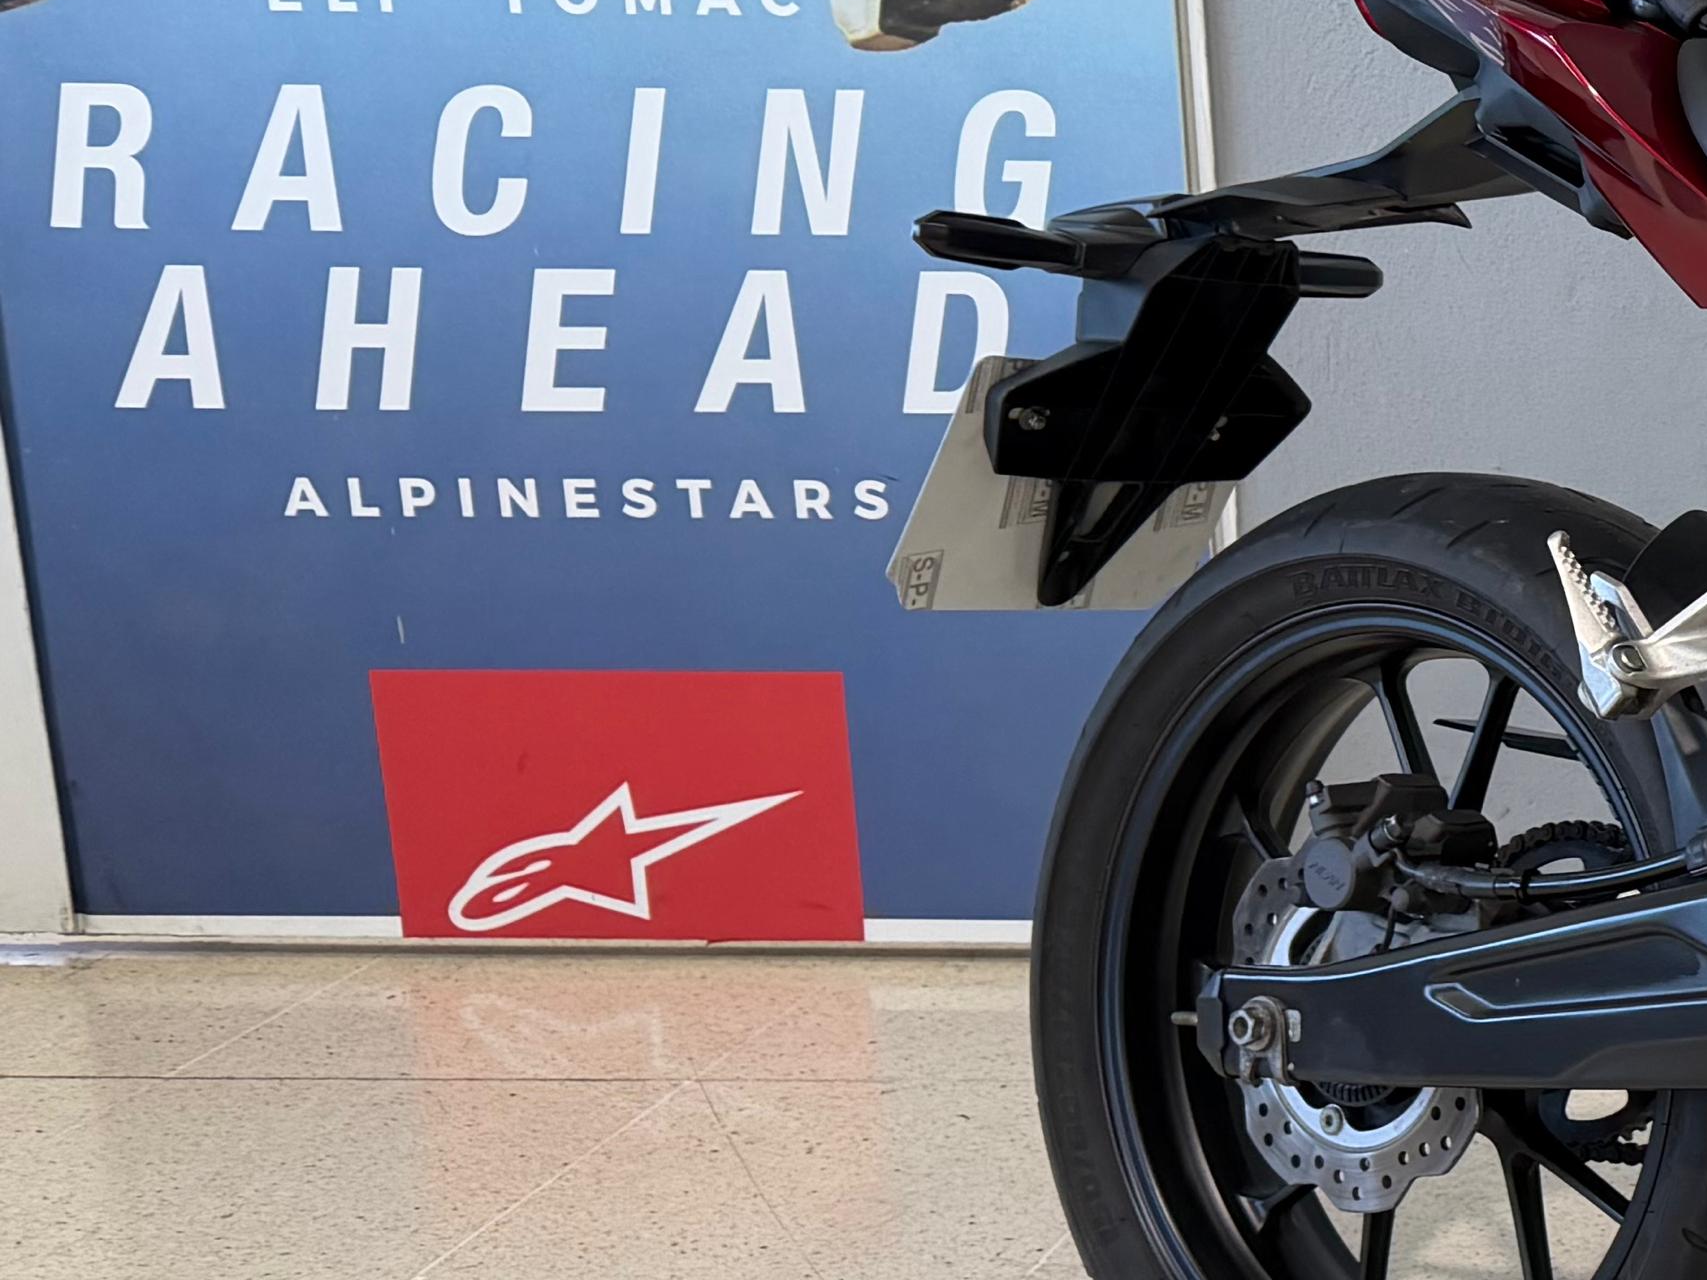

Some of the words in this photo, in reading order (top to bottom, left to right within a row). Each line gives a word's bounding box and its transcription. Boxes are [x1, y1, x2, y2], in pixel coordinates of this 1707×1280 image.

[51, 82, 1058, 236] RACING
[115, 265, 1010, 414] AHEAD
[284, 477, 891, 520] ALPINESTARS
